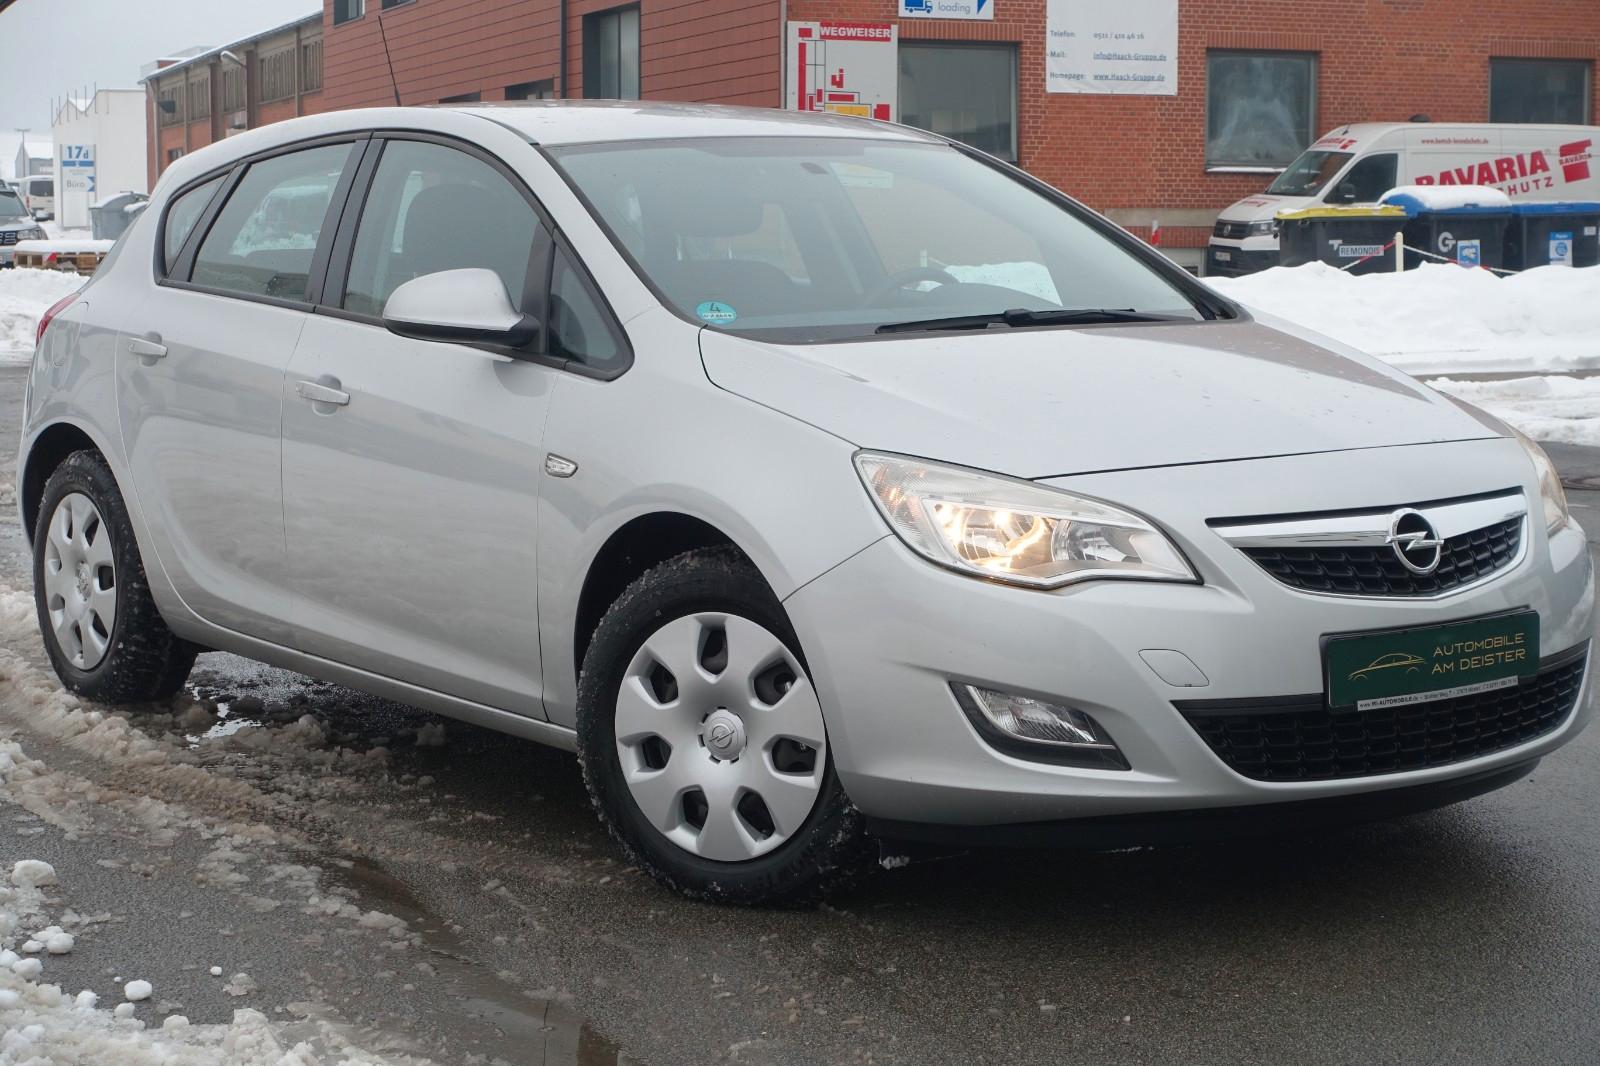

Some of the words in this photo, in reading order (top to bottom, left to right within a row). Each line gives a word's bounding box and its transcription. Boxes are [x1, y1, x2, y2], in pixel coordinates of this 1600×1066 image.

[938, 2, 970, 14] loading
[820, 26, 891, 39] WEGWEISER
[1050, 30, 1076, 38] Telefon:
[1340, 246, 1381, 256] REMONDI
[1433, 633, 1524, 657] AUTOMOBILE
[1432, 662, 1454, 675] AM
[1460, 648, 1526, 670] DEISTER
